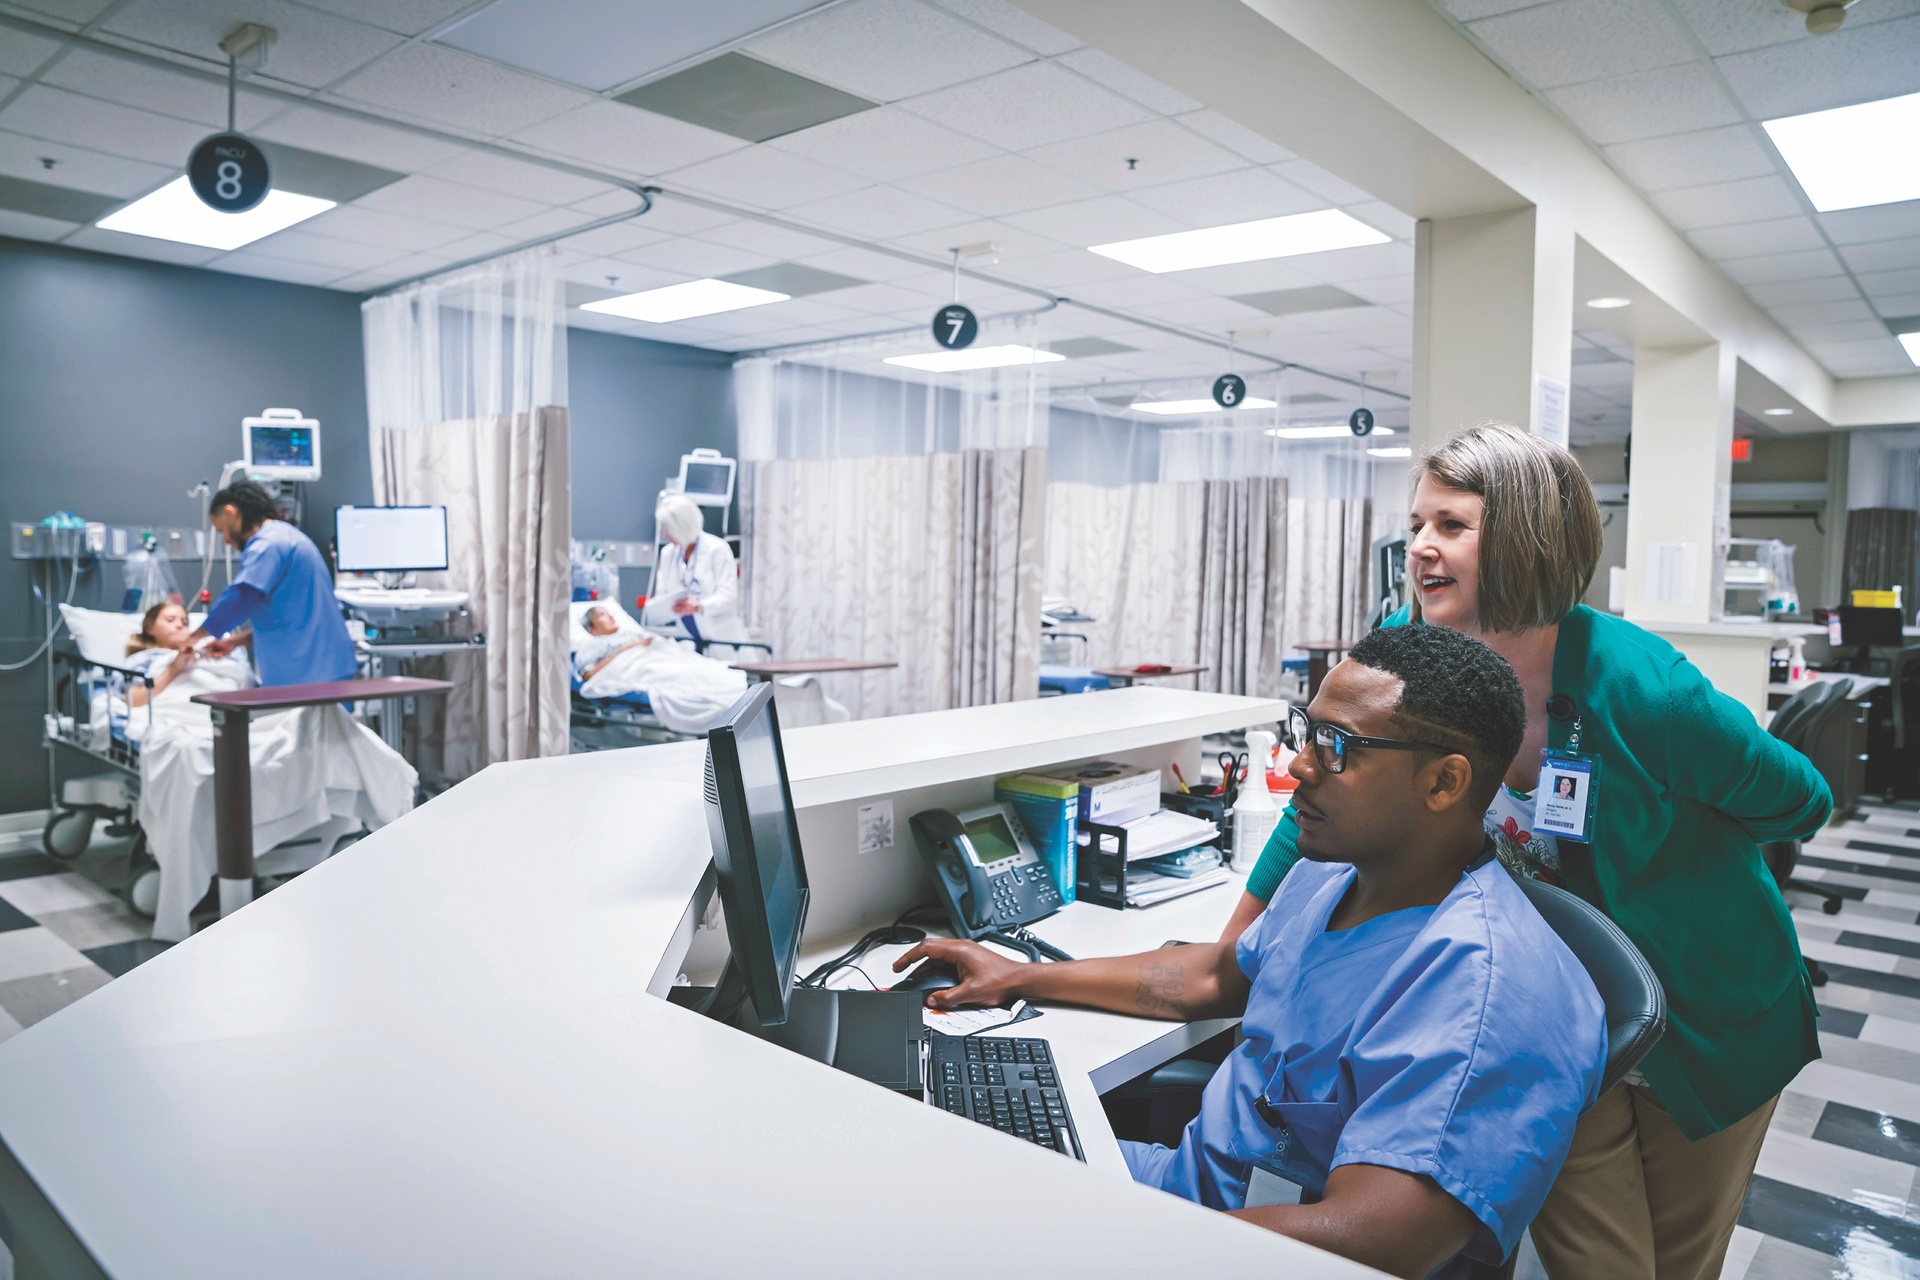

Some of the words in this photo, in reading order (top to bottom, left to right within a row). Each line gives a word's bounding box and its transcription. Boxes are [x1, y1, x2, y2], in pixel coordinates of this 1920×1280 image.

[216, 161, 242, 200] 8
[946, 319, 964, 345] 7
[1222, 384, 1236, 405] 6
[1356, 416, 1367, 434] 5
[1094, 801, 1101, 812] M
